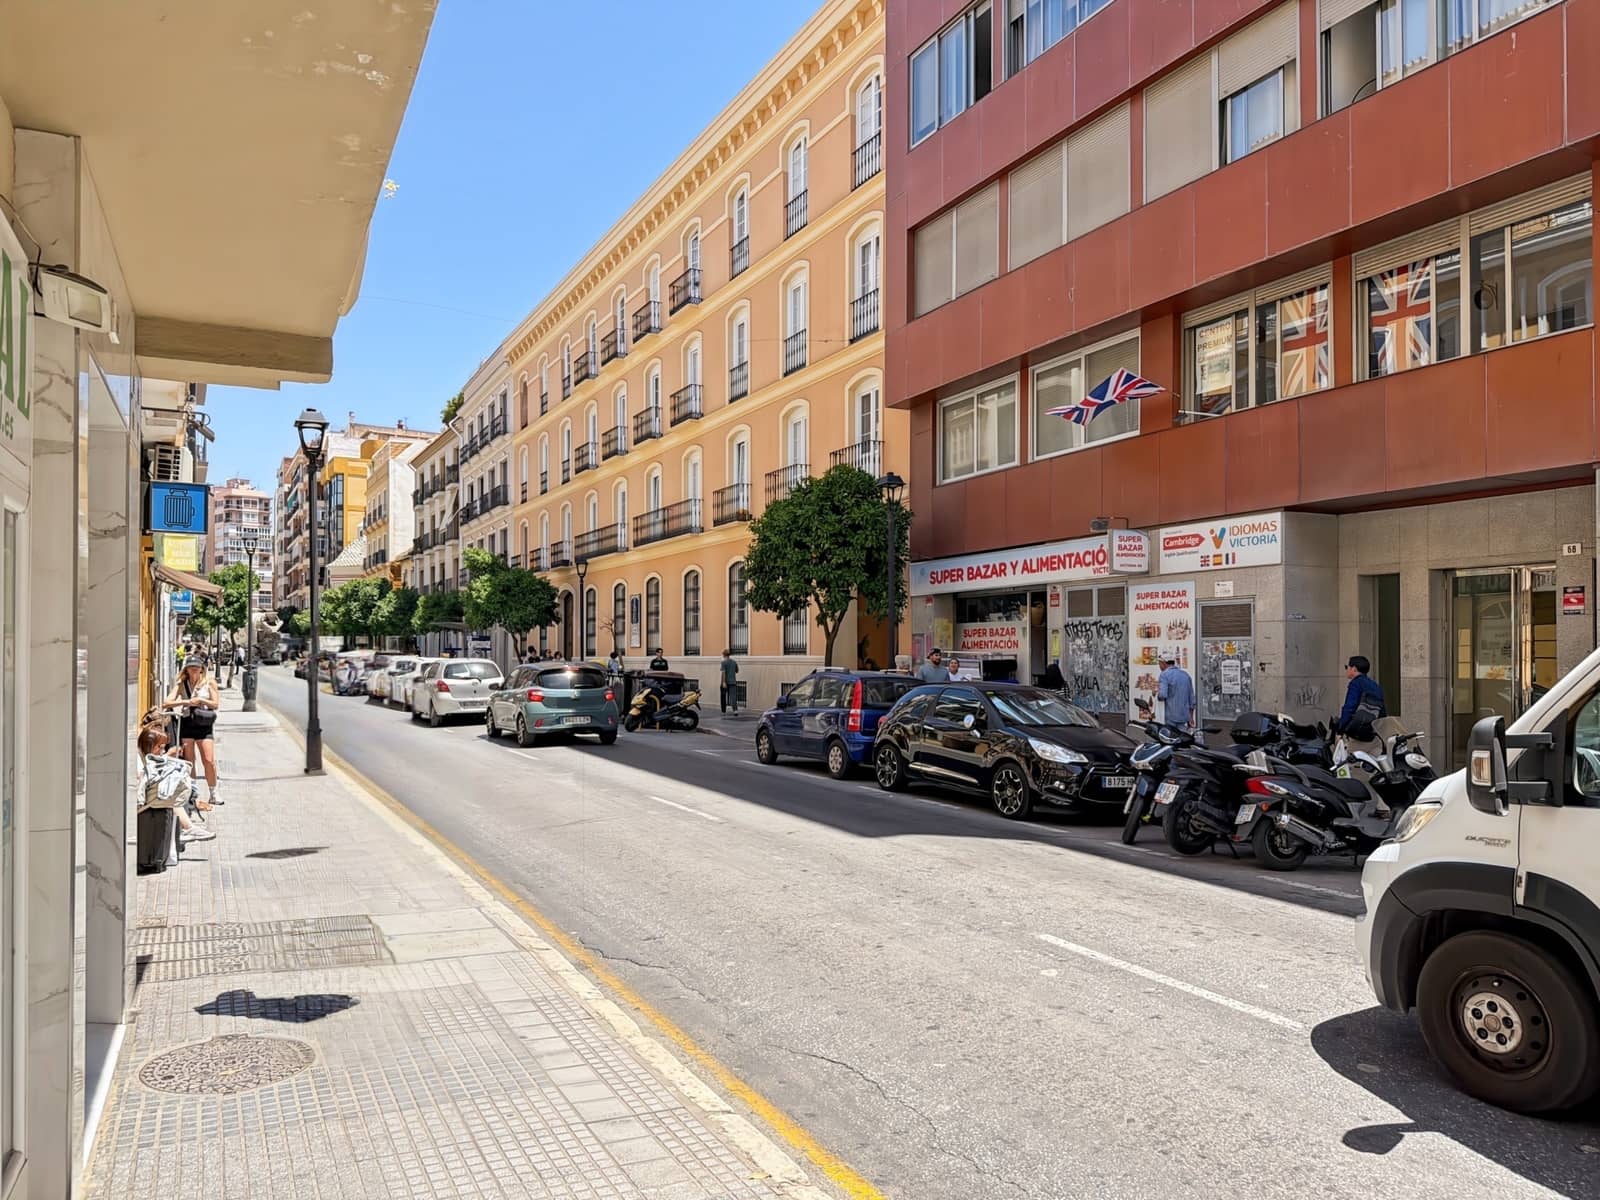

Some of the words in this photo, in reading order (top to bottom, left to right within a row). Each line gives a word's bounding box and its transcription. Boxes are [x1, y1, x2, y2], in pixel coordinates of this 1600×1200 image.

[1229, 520, 1277, 536] IDIOMAS
[1164, 535, 1200, 547] Cambridge
[1229, 534, 1277, 548] VICTORIA
[1117, 543, 1143, 551] BAZAR
[929, 567, 964, 584] SUPER
[967, 562, 1007, 581] BAZAR
[1010, 560, 1019, 575] Y
[1021, 544, 1109, 574] ALIMENTACIÓ
[1136, 591, 1159, 600] SUPER
[1161, 590, 1187, 599] BAZAR
[1135, 600, 1189, 611] ALIMENTACIÓN
[963, 628, 987, 638] SUPER
[989, 627, 1016, 637] BAZAR
[961, 638, 1018, 649] ALIMENTACIÓN
[1074, 675, 1100, 691] XULA
